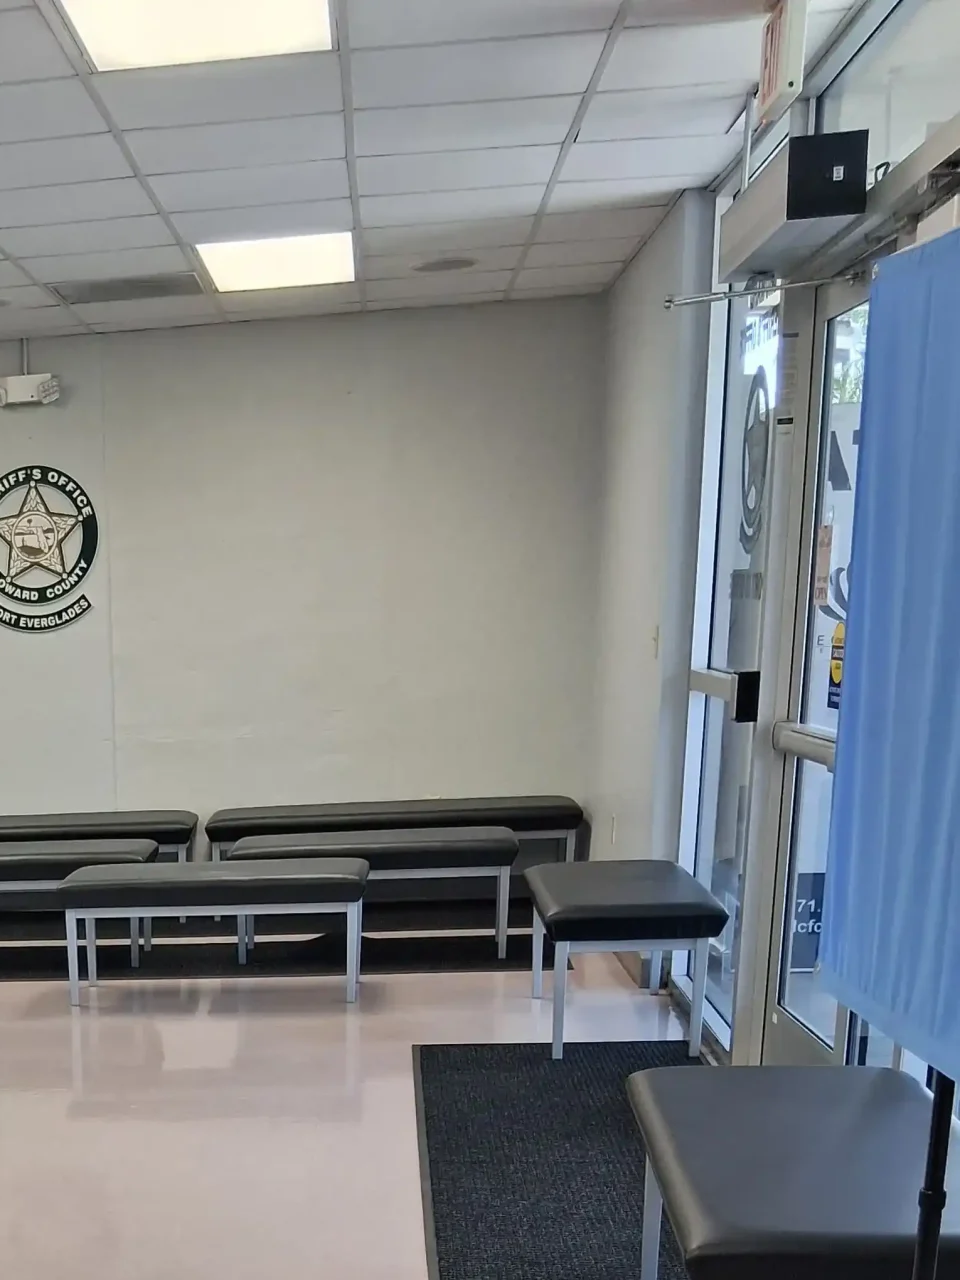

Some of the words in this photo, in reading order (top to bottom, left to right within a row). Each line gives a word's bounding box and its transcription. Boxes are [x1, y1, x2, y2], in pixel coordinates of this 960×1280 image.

[47, 471, 93, 518] OFFICE
[46, 559, 88, 598] COUNTY
[19, 598, 89, 628] EVERGLADES
